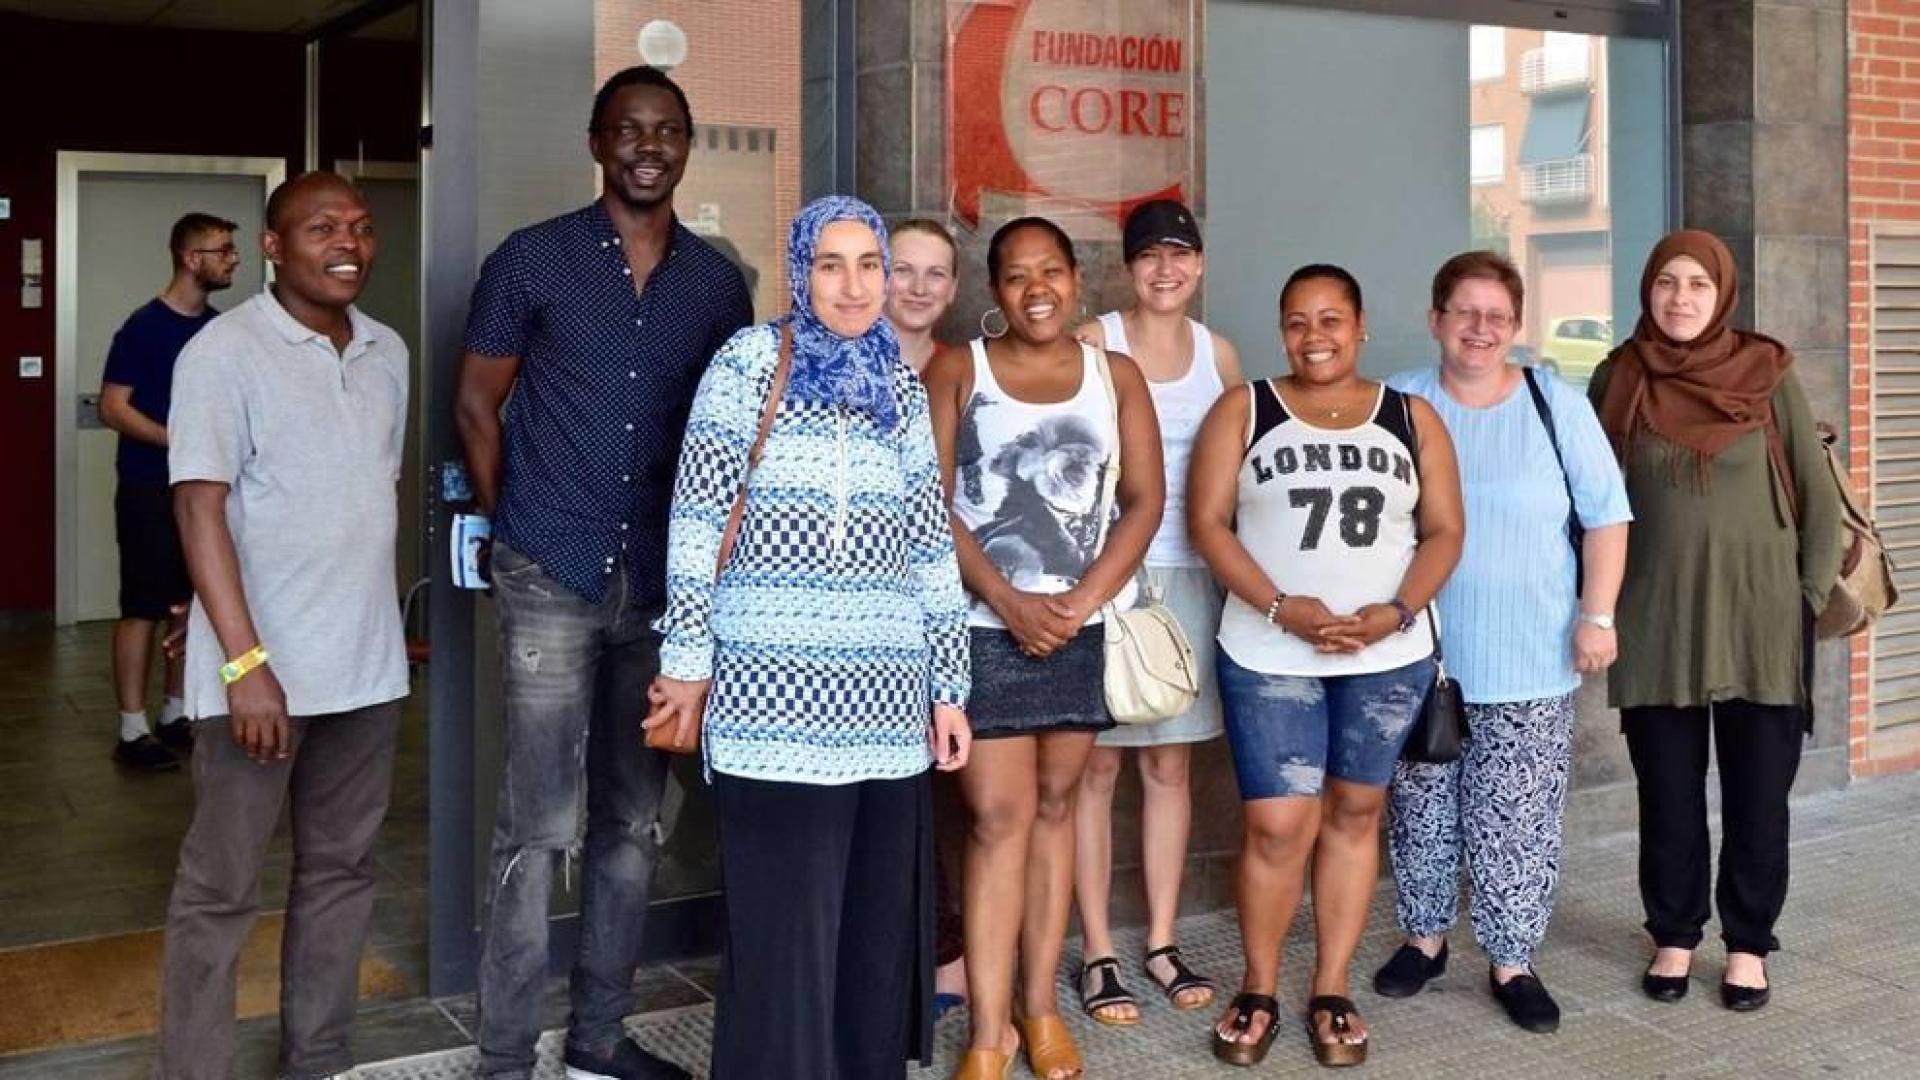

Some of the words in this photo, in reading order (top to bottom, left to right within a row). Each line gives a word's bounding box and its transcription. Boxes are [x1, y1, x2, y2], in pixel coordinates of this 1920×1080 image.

[1032, 30, 1182, 73] FUNDACIÓN
[1030, 85, 1185, 137] CORE
[1251, 443, 1411, 485] LONDON
[1288, 486, 1386, 551] 78
